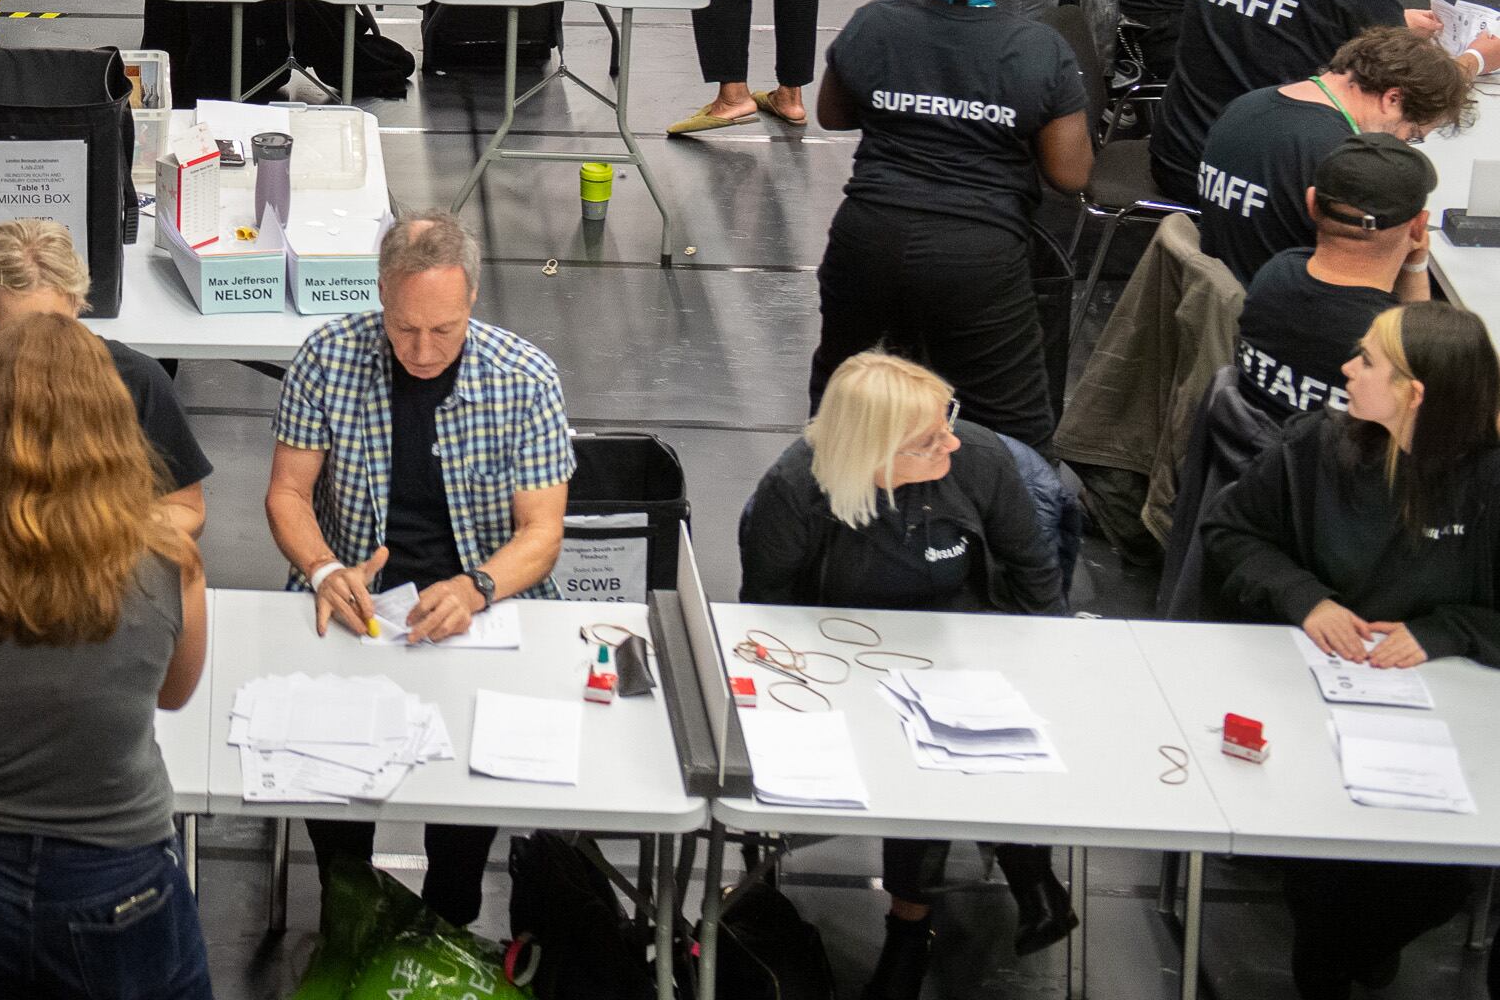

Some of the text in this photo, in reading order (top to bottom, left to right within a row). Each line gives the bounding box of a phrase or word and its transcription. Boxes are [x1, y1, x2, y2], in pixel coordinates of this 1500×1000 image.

[872, 90, 1017, 128] SUPERVISOR
[16, 184, 38, 192] Table
[1198, 161, 1268, 218] STAFF
[44, 194, 71, 203] BOX
[208, 275, 279, 286] Max Jefferson
[305, 277, 377, 286] Max Jefferson
[215, 288, 273, 301] NELSON
[312, 289, 370, 302] NELSON
[566, 577, 621, 592] SCWB
